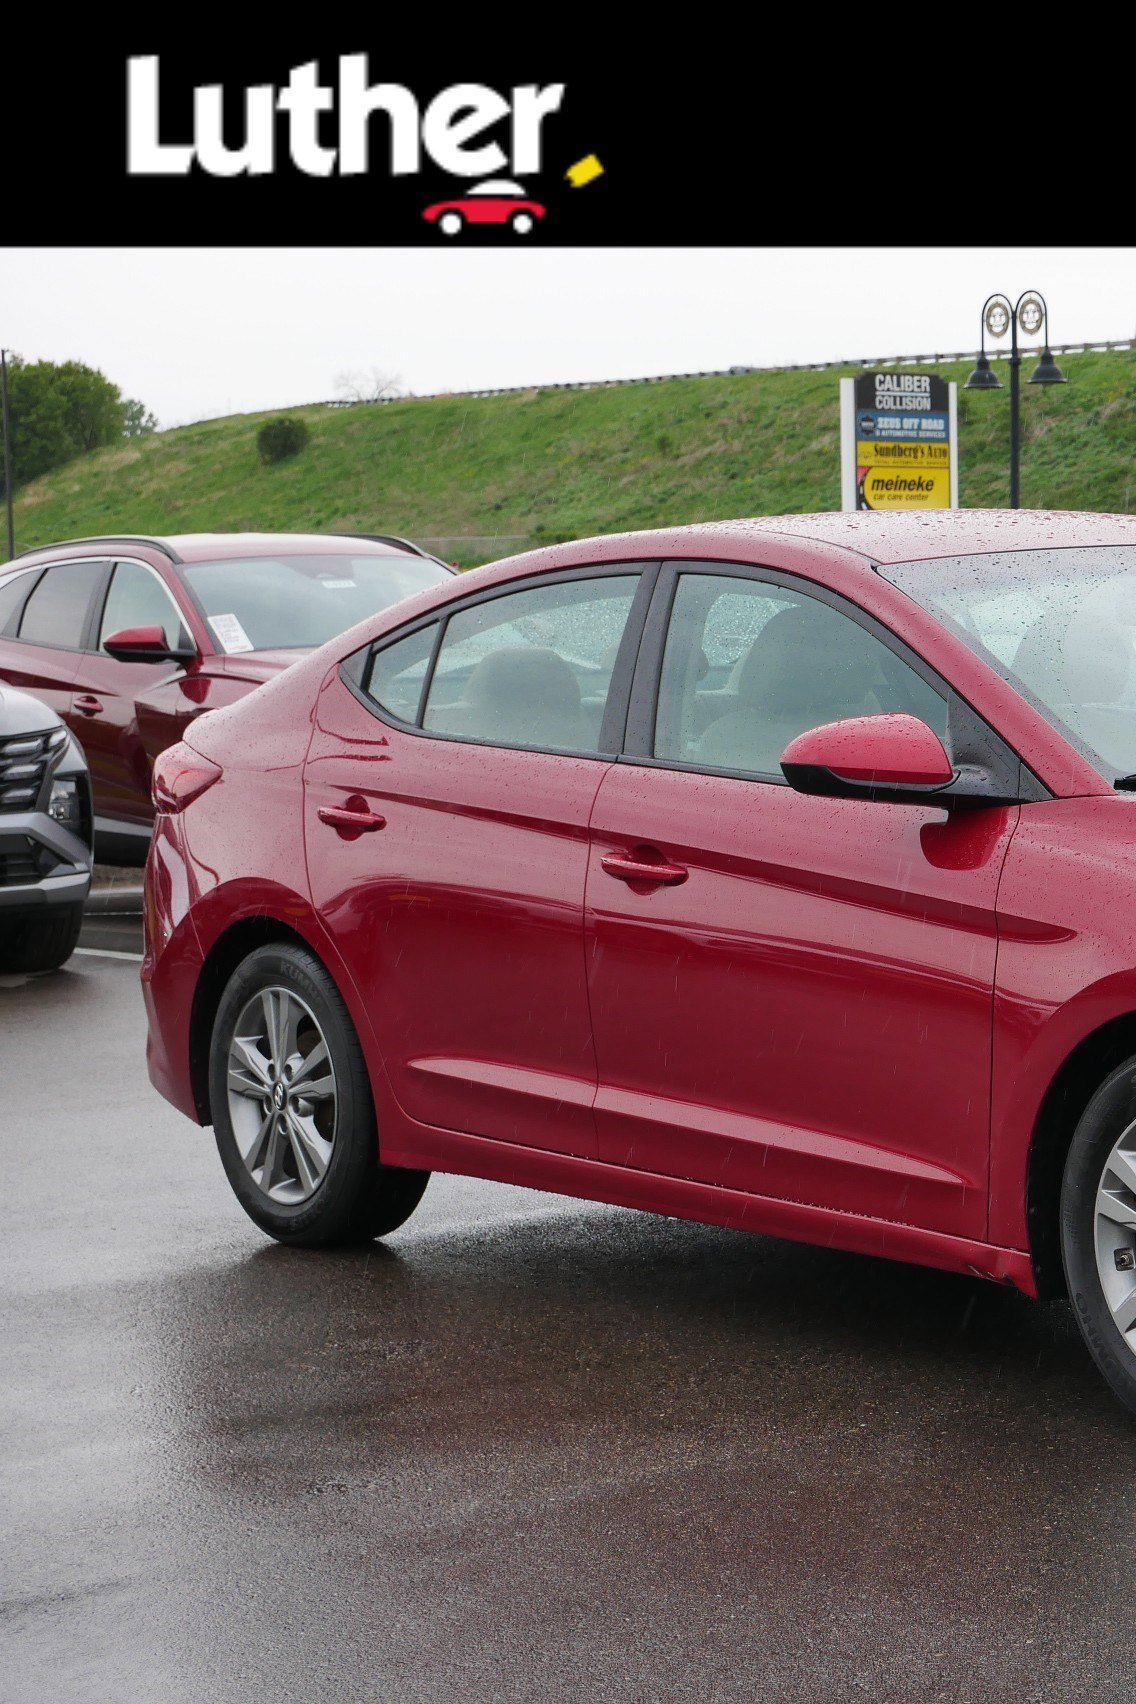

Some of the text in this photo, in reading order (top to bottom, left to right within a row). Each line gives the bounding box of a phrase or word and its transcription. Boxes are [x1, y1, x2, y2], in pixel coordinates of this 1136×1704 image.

[875, 374, 931, 393] CALIBER
[875, 397, 931, 410] COLLISION
[874, 443, 925, 459] Sundberg's
[871, 475, 935, 491] meineke
[905, 492, 929, 501] center
